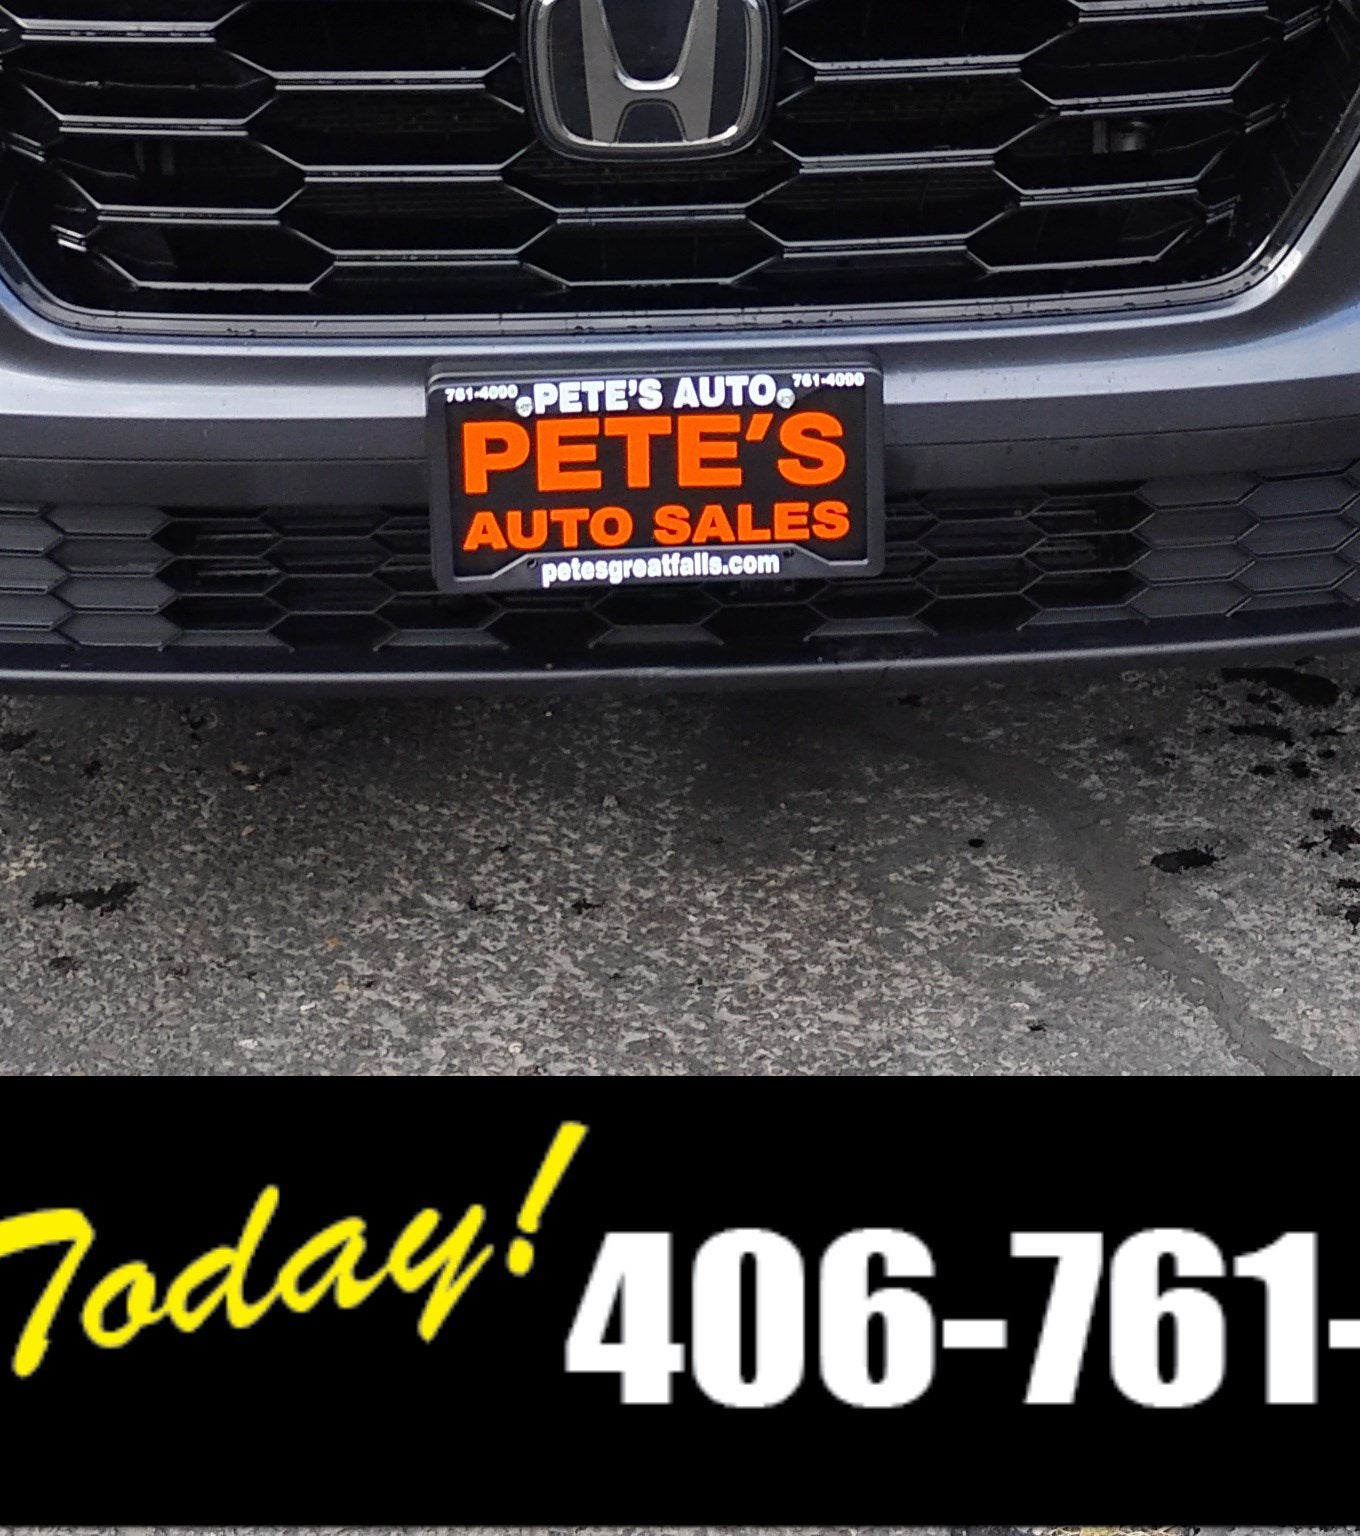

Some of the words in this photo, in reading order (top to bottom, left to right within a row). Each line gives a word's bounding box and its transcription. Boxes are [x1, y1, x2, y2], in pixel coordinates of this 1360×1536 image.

[533, 376, 663, 414] PETE'S
[672, 372, 777, 409] AUTO
[462, 411, 846, 495] PETE'S
[463, 506, 634, 551] AUTO
[653, 500, 850, 545] SALES
[541, 551, 780, 588] petesgreatfalls.com
